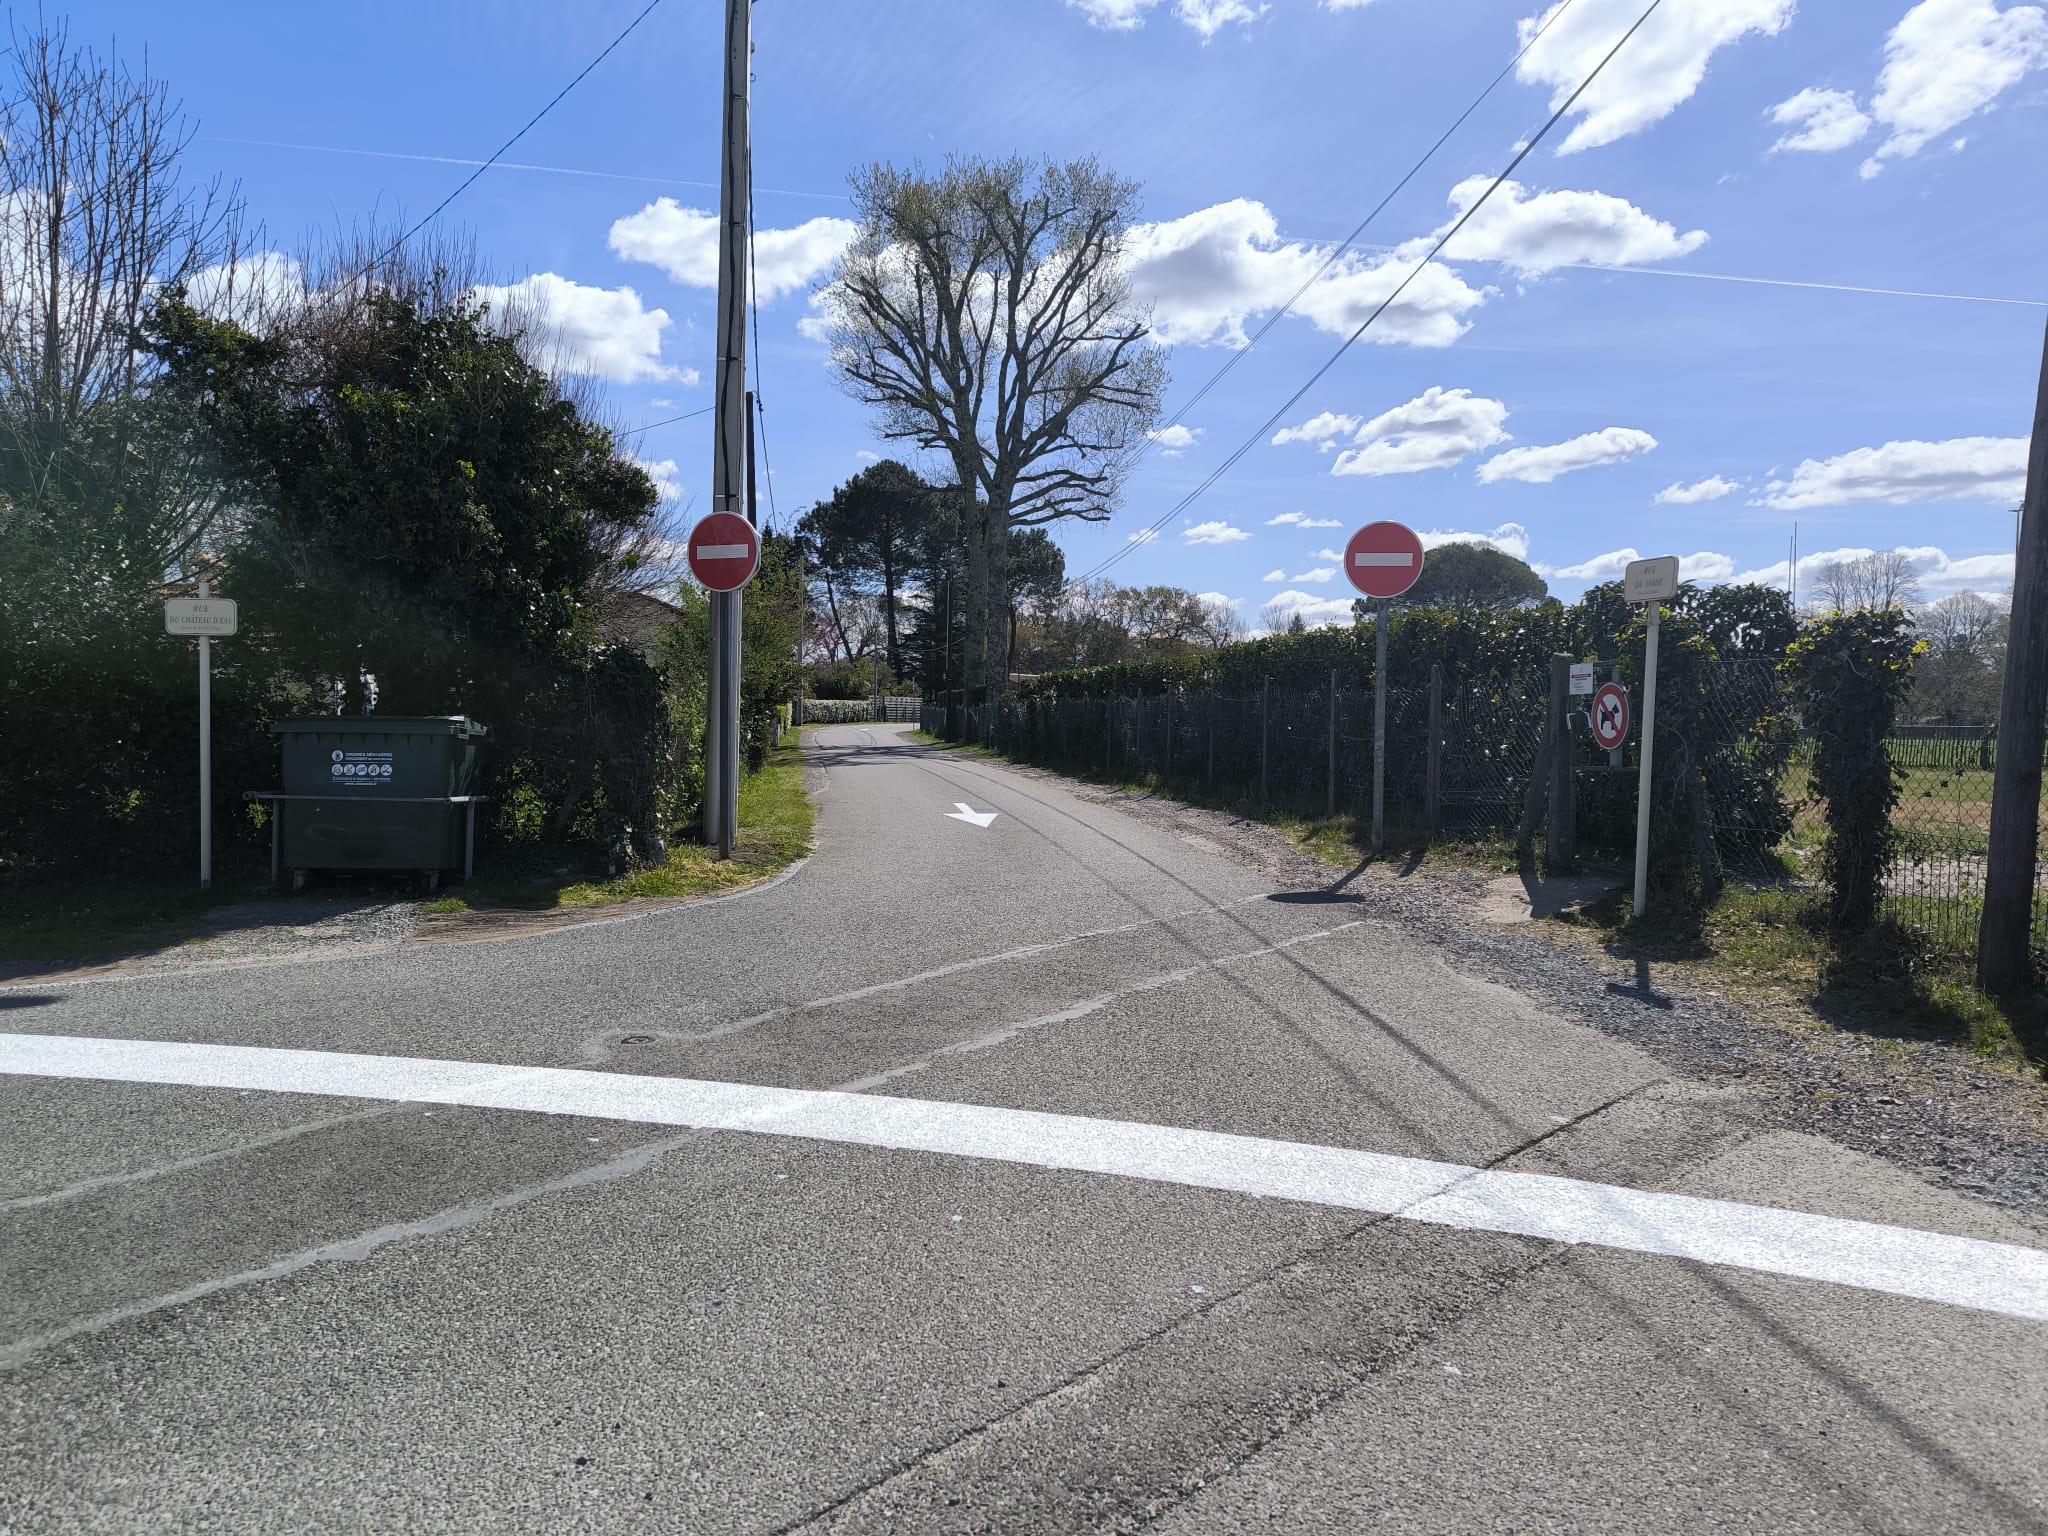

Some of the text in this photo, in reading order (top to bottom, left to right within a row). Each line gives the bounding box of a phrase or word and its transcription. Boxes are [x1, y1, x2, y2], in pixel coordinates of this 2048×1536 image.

[193, 604, 209, 613] RUE
[169, 614, 233, 625] DU CHÂTEAU D'EAU
